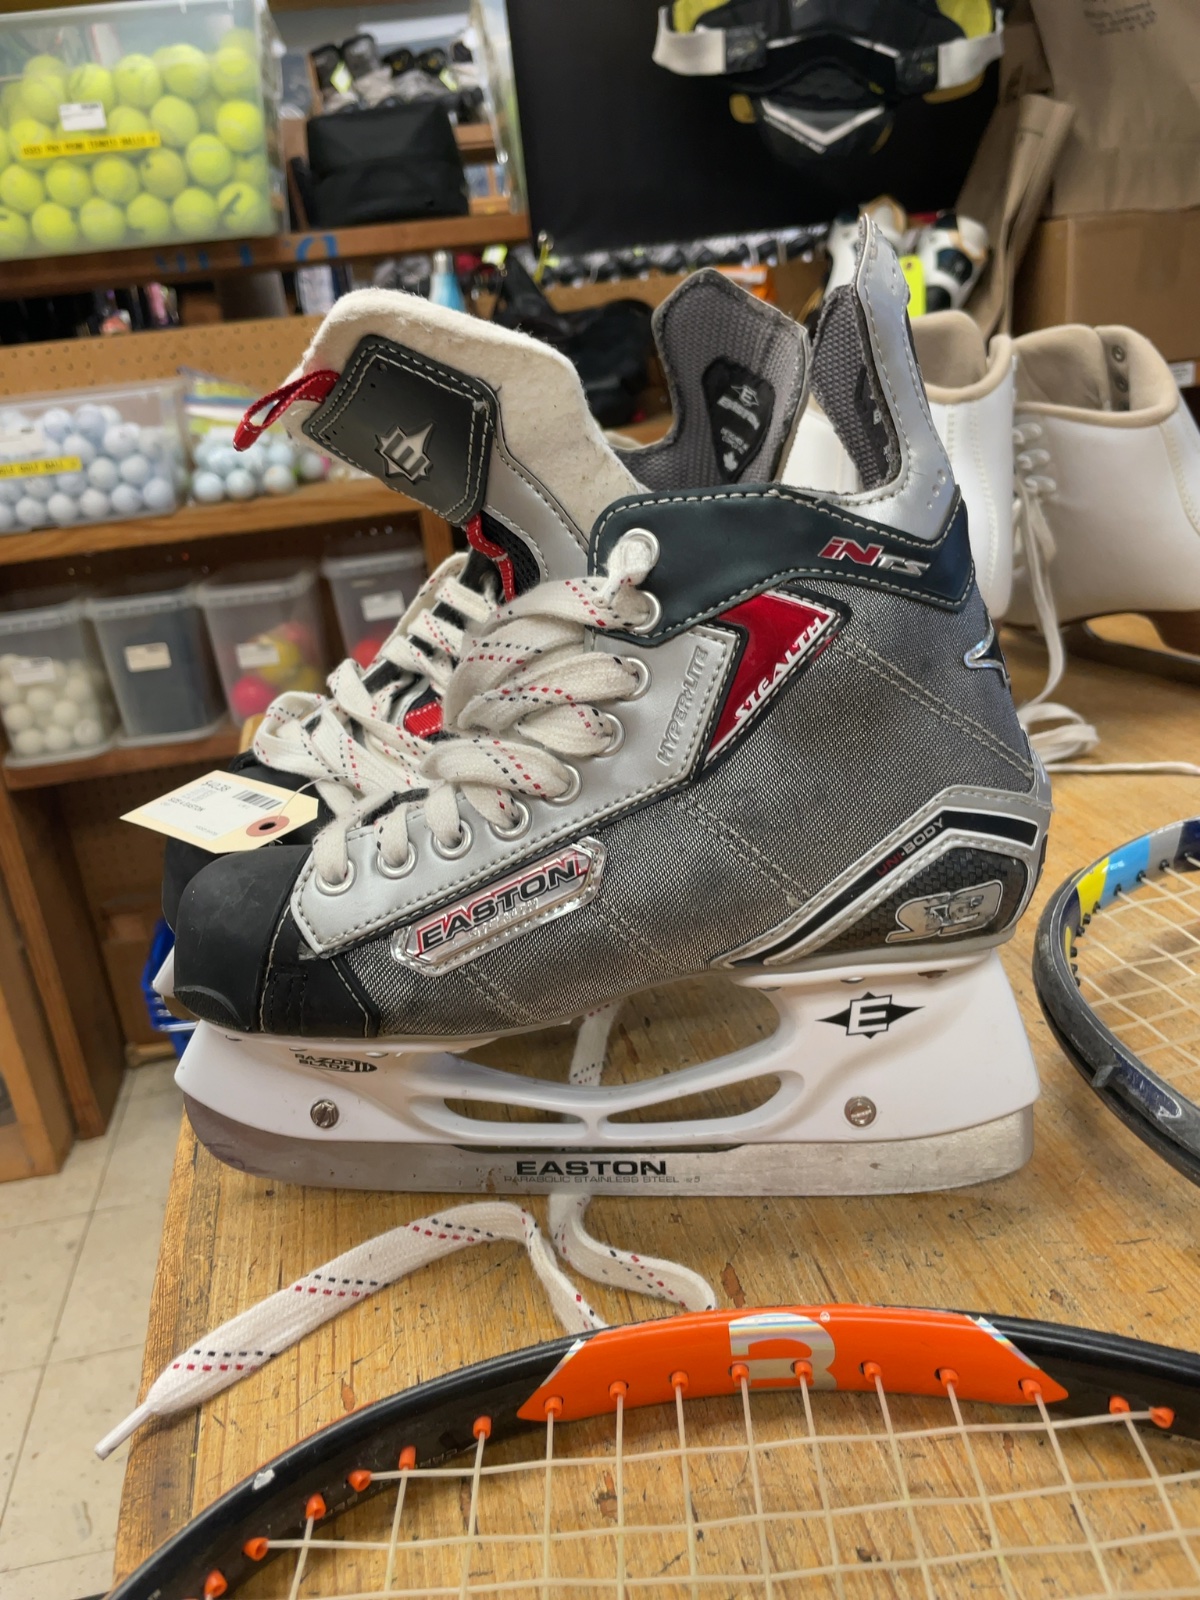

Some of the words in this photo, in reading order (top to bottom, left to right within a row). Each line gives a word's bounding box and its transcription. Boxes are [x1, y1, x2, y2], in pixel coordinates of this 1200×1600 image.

[733, 616, 824, 726] STEALTH
[875, 817, 944, 877] UNI-BODY
[419, 854, 579, 952] EASTON
[504, 1175, 571, 1184] PARABOLIC
[574, 1175, 639, 1184] STAINLESS
[643, 1175, 680, 1184] STEEL
[516, 1160, 667, 1176] EASTON
